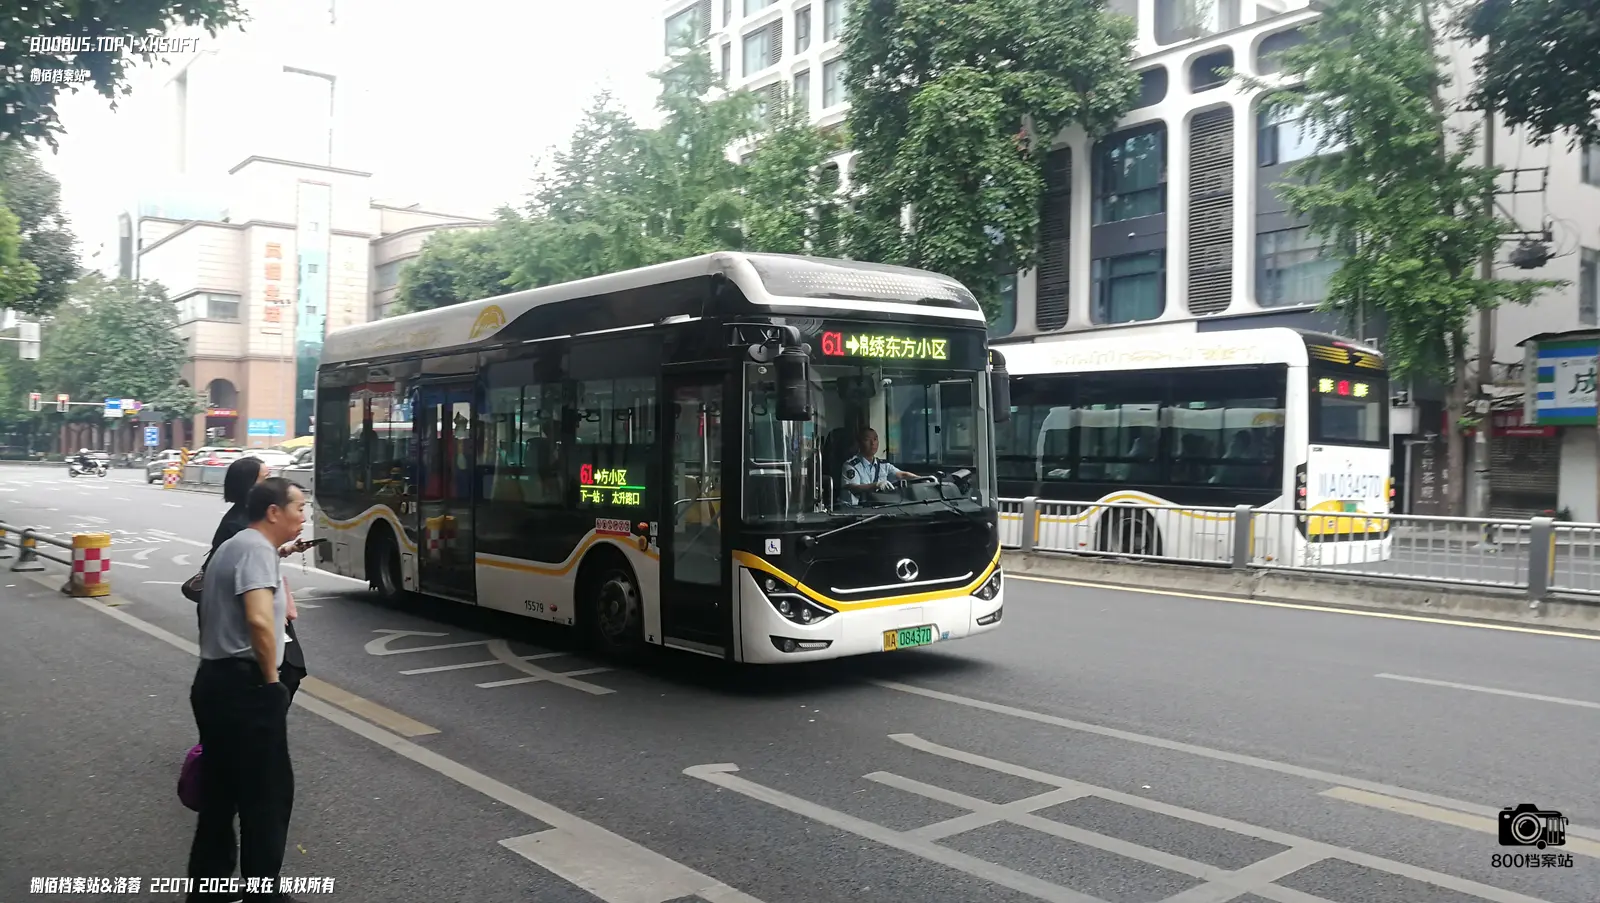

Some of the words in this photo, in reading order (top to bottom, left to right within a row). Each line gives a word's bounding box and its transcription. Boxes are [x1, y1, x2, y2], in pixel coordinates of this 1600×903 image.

[822, 331, 845, 356] 61
[580, 463, 594, 485] 61
[600, 468, 627, 486] 方小区
[524, 599, 545, 614] 15579
